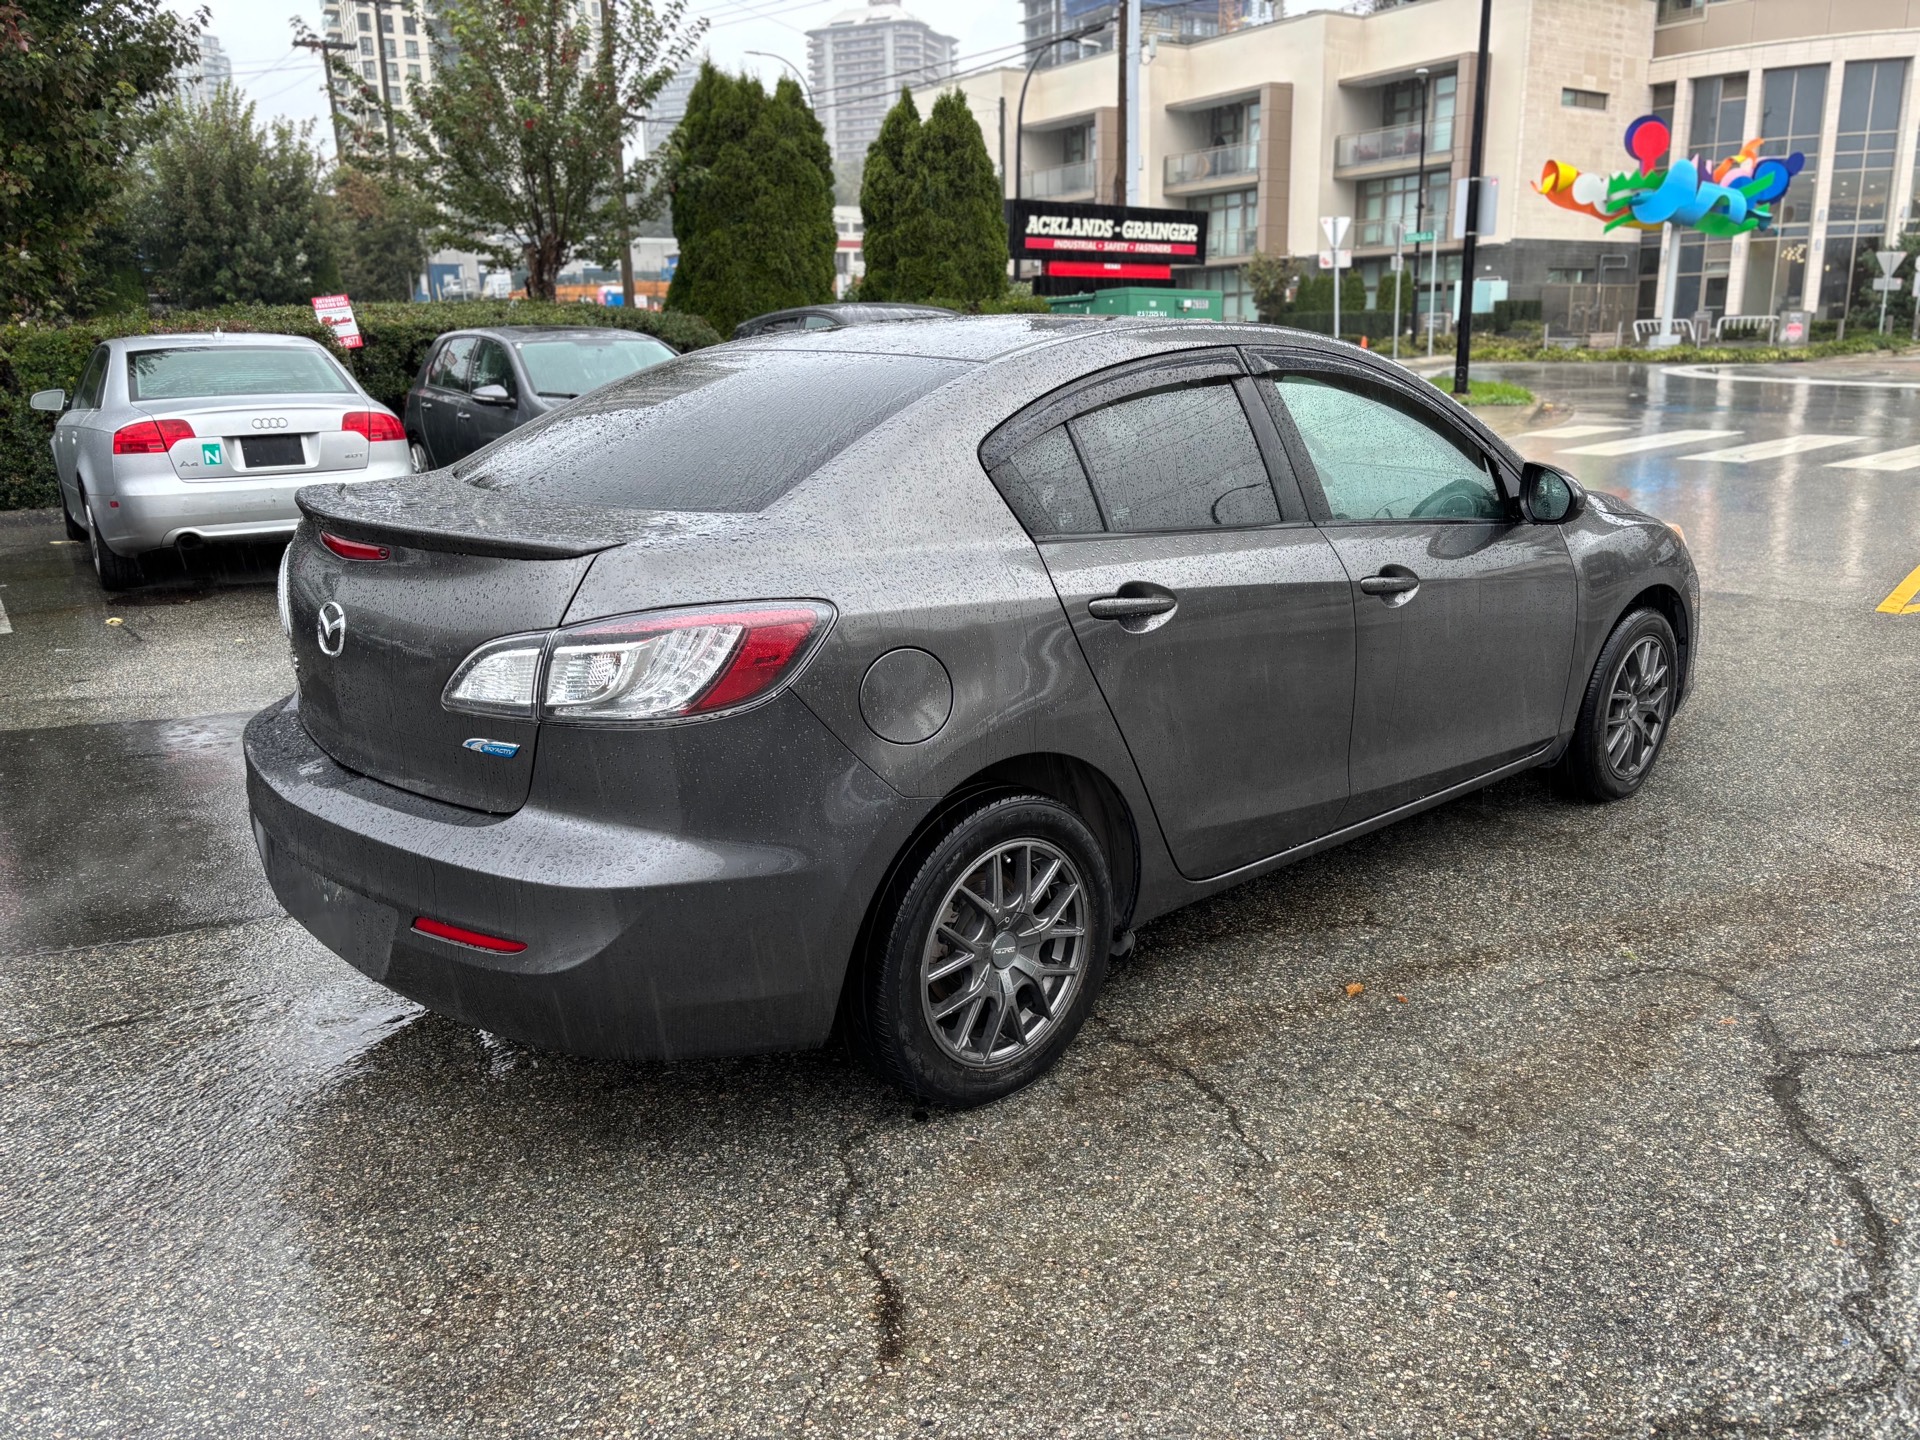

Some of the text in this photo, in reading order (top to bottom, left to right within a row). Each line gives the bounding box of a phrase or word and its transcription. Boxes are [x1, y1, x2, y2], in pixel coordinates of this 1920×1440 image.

[1053, 239, 1172, 253] INDUSTRIAL SAFETY FASTENERS
[204, 450, 221, 464] N
